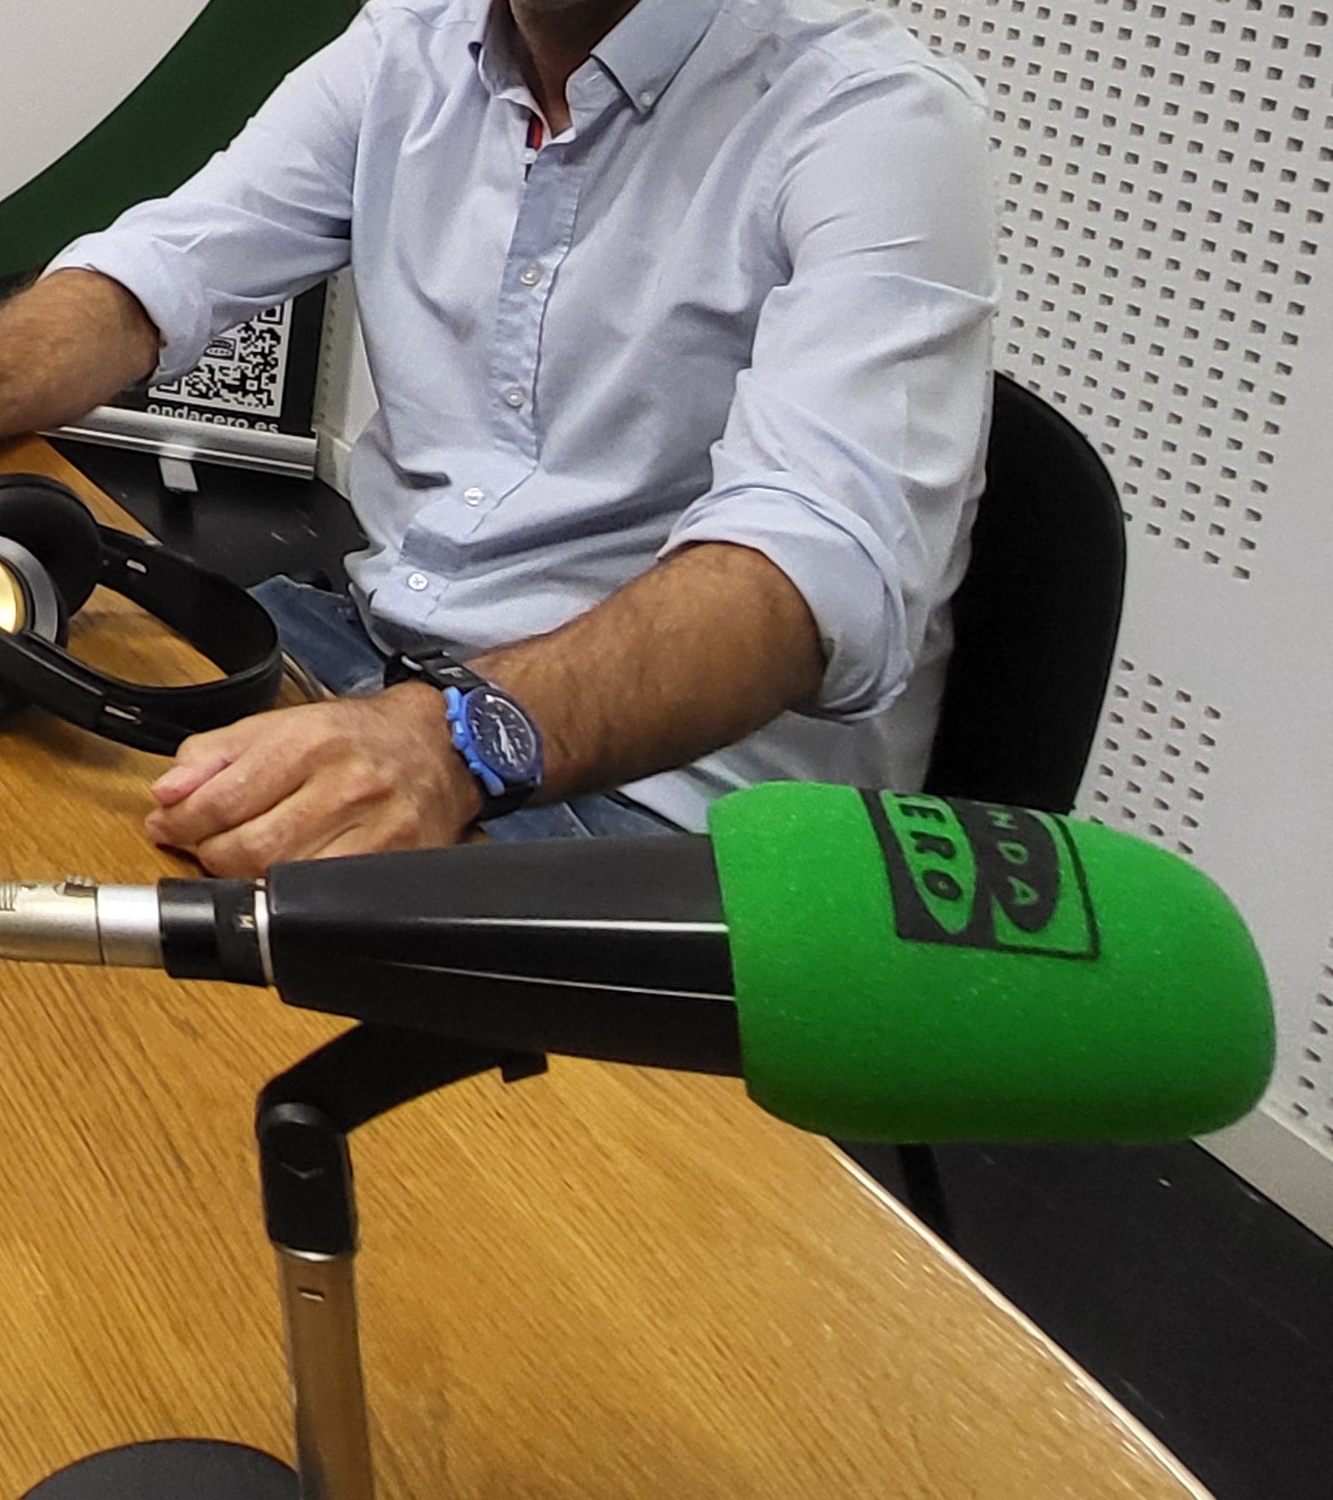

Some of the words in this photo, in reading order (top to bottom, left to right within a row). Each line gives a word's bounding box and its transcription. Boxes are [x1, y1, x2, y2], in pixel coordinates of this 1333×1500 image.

[146, 403, 280, 434] ondaceroes
[898, 796, 963, 901] ERO
[985, 804, 1040, 906] NDA
